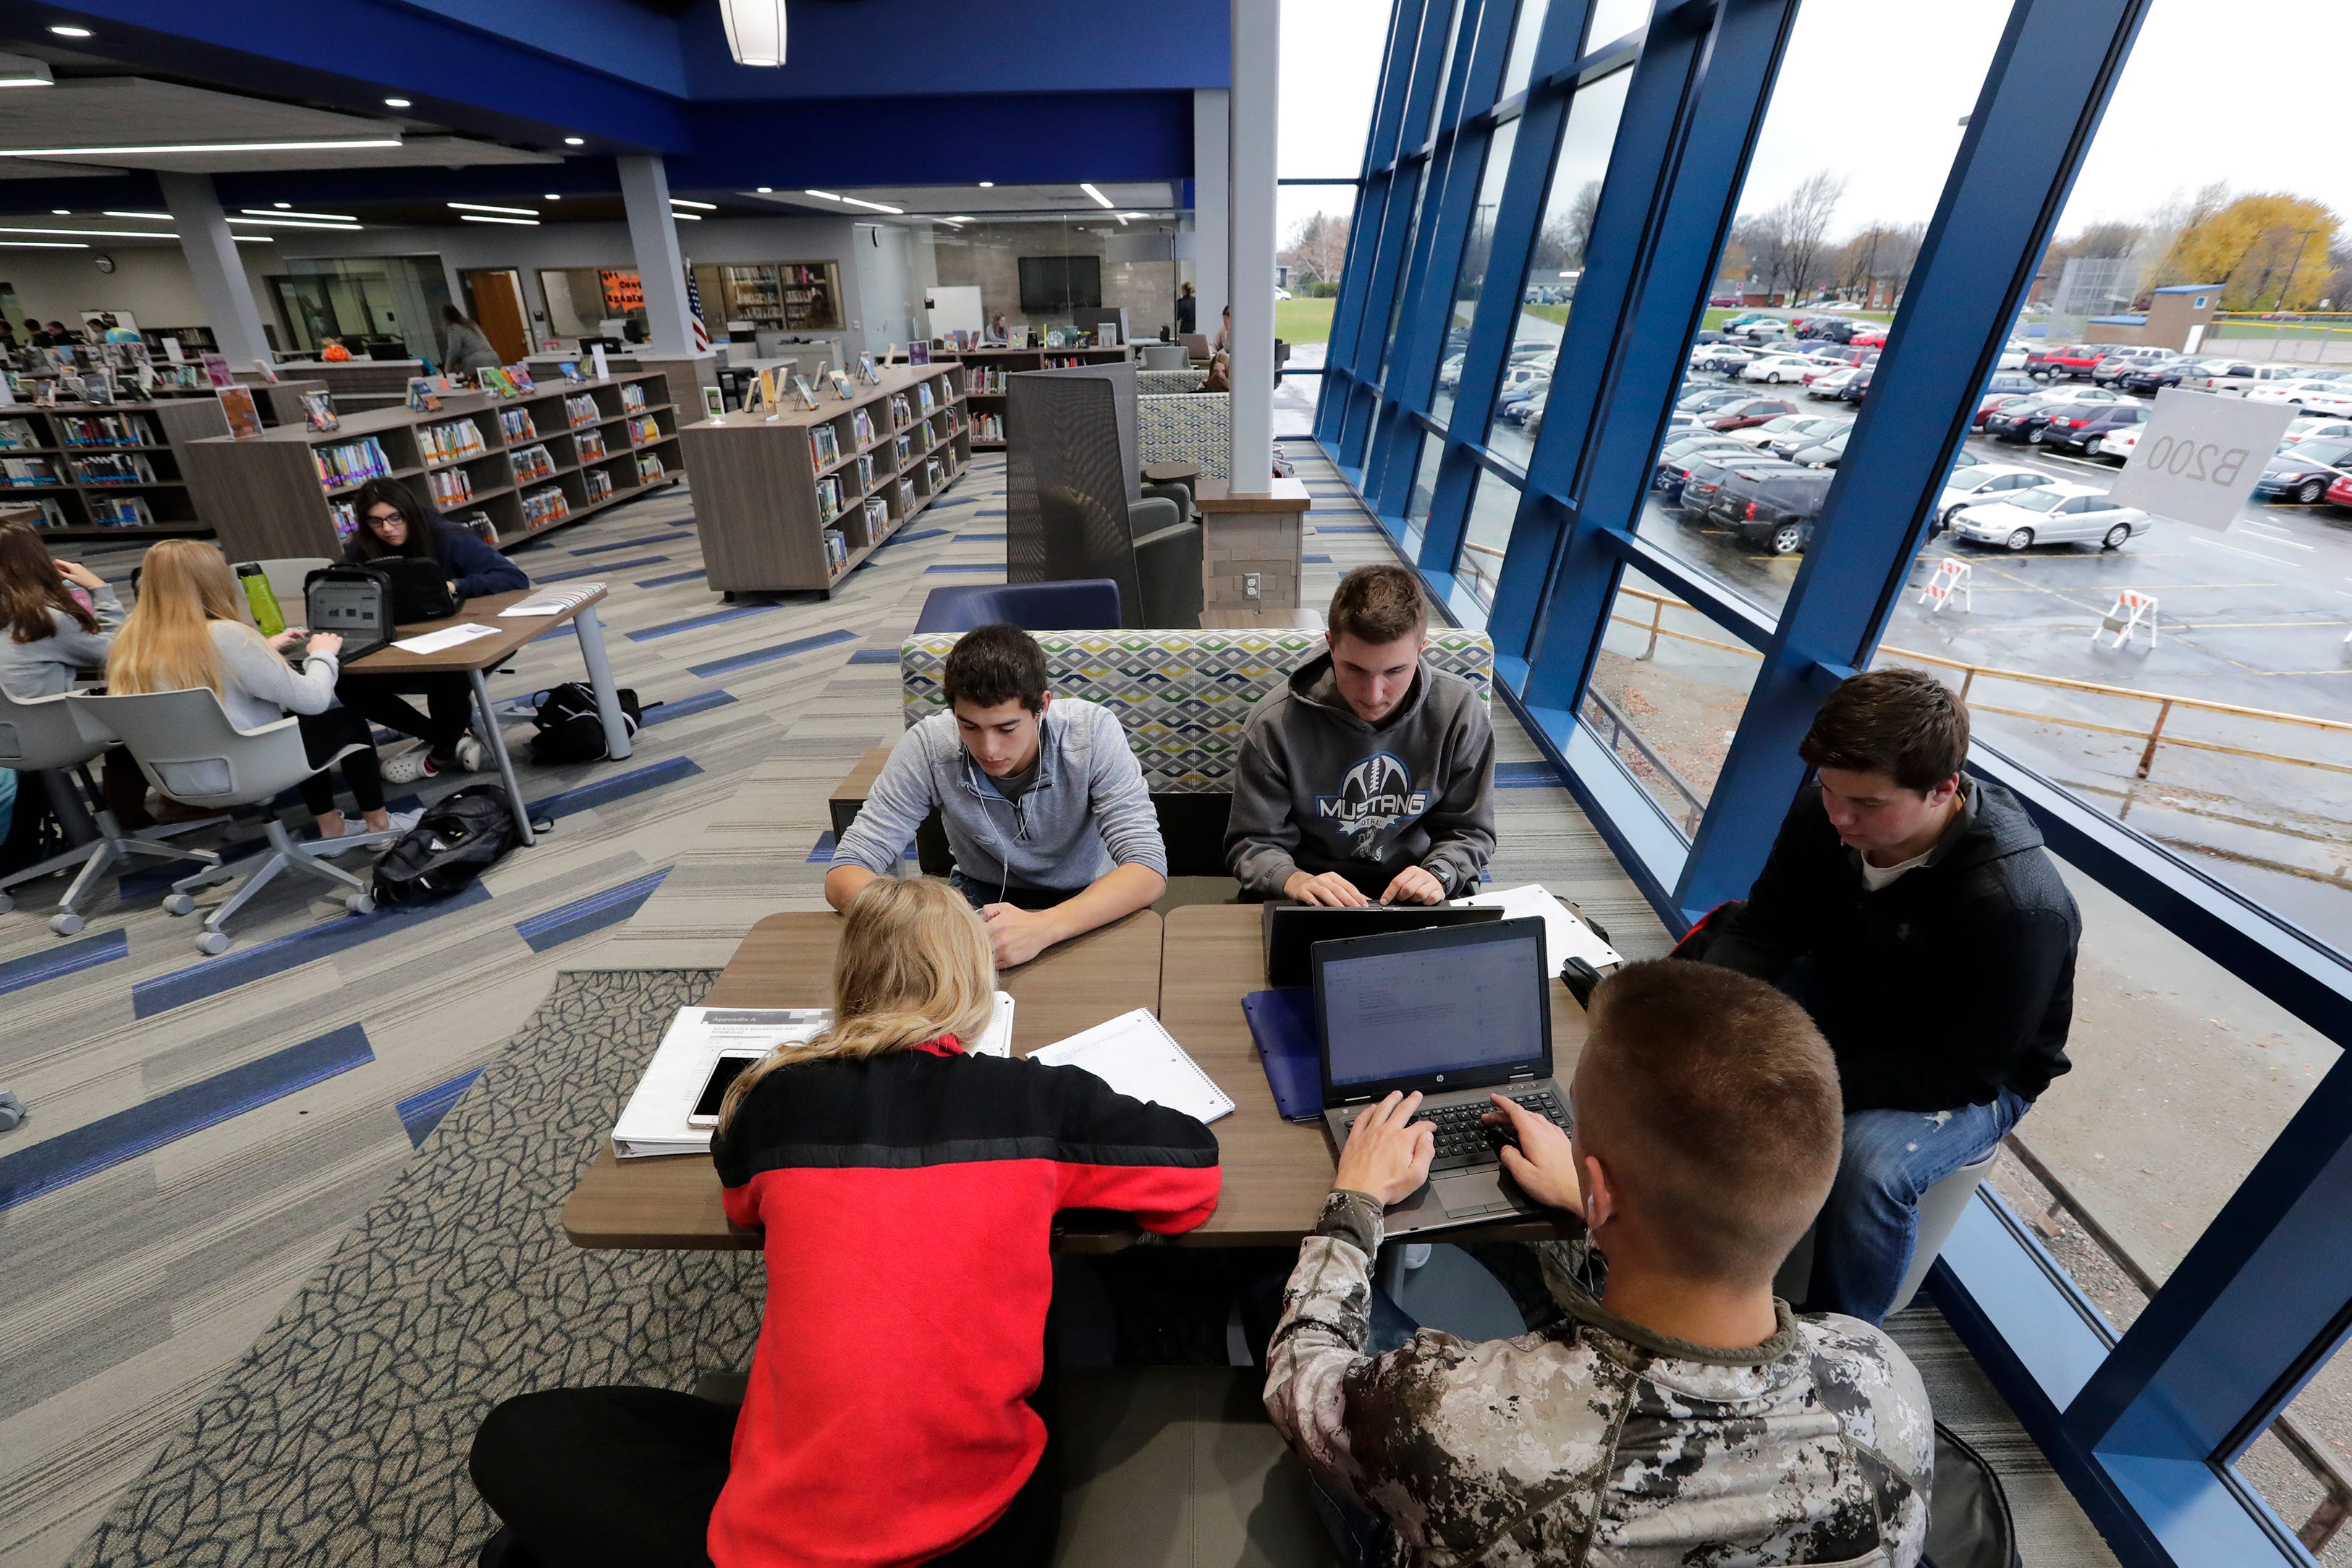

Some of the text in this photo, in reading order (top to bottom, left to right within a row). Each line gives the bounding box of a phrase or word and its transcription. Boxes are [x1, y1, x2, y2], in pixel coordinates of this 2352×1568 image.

[606, 294, 643, 303] READIN
[1319, 794, 1426, 821] MUSTANG
[1757, 1554, 1777, 1567] VEIL
